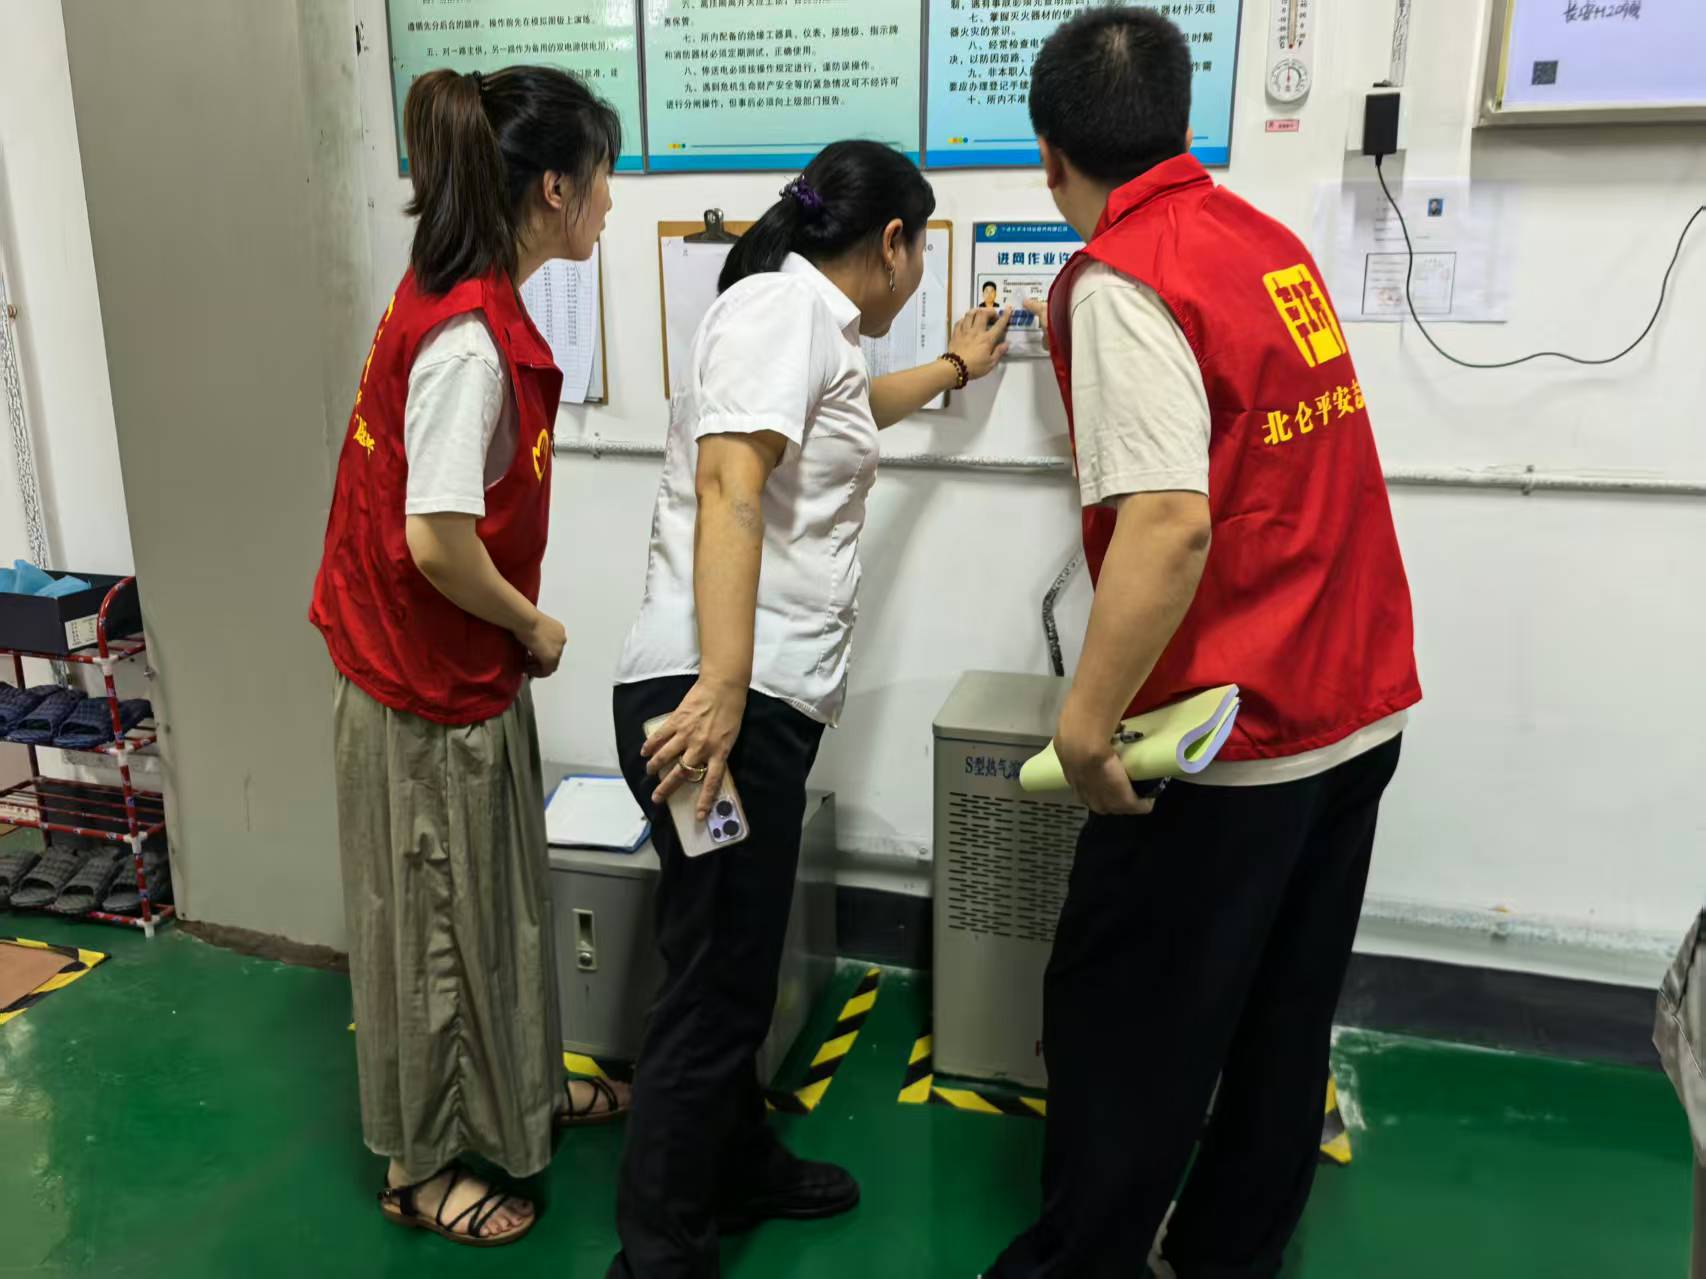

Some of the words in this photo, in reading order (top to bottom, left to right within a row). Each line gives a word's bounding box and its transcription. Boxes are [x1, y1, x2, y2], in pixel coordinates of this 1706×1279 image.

[968, 66, 1031, 78] 九、非本职人
